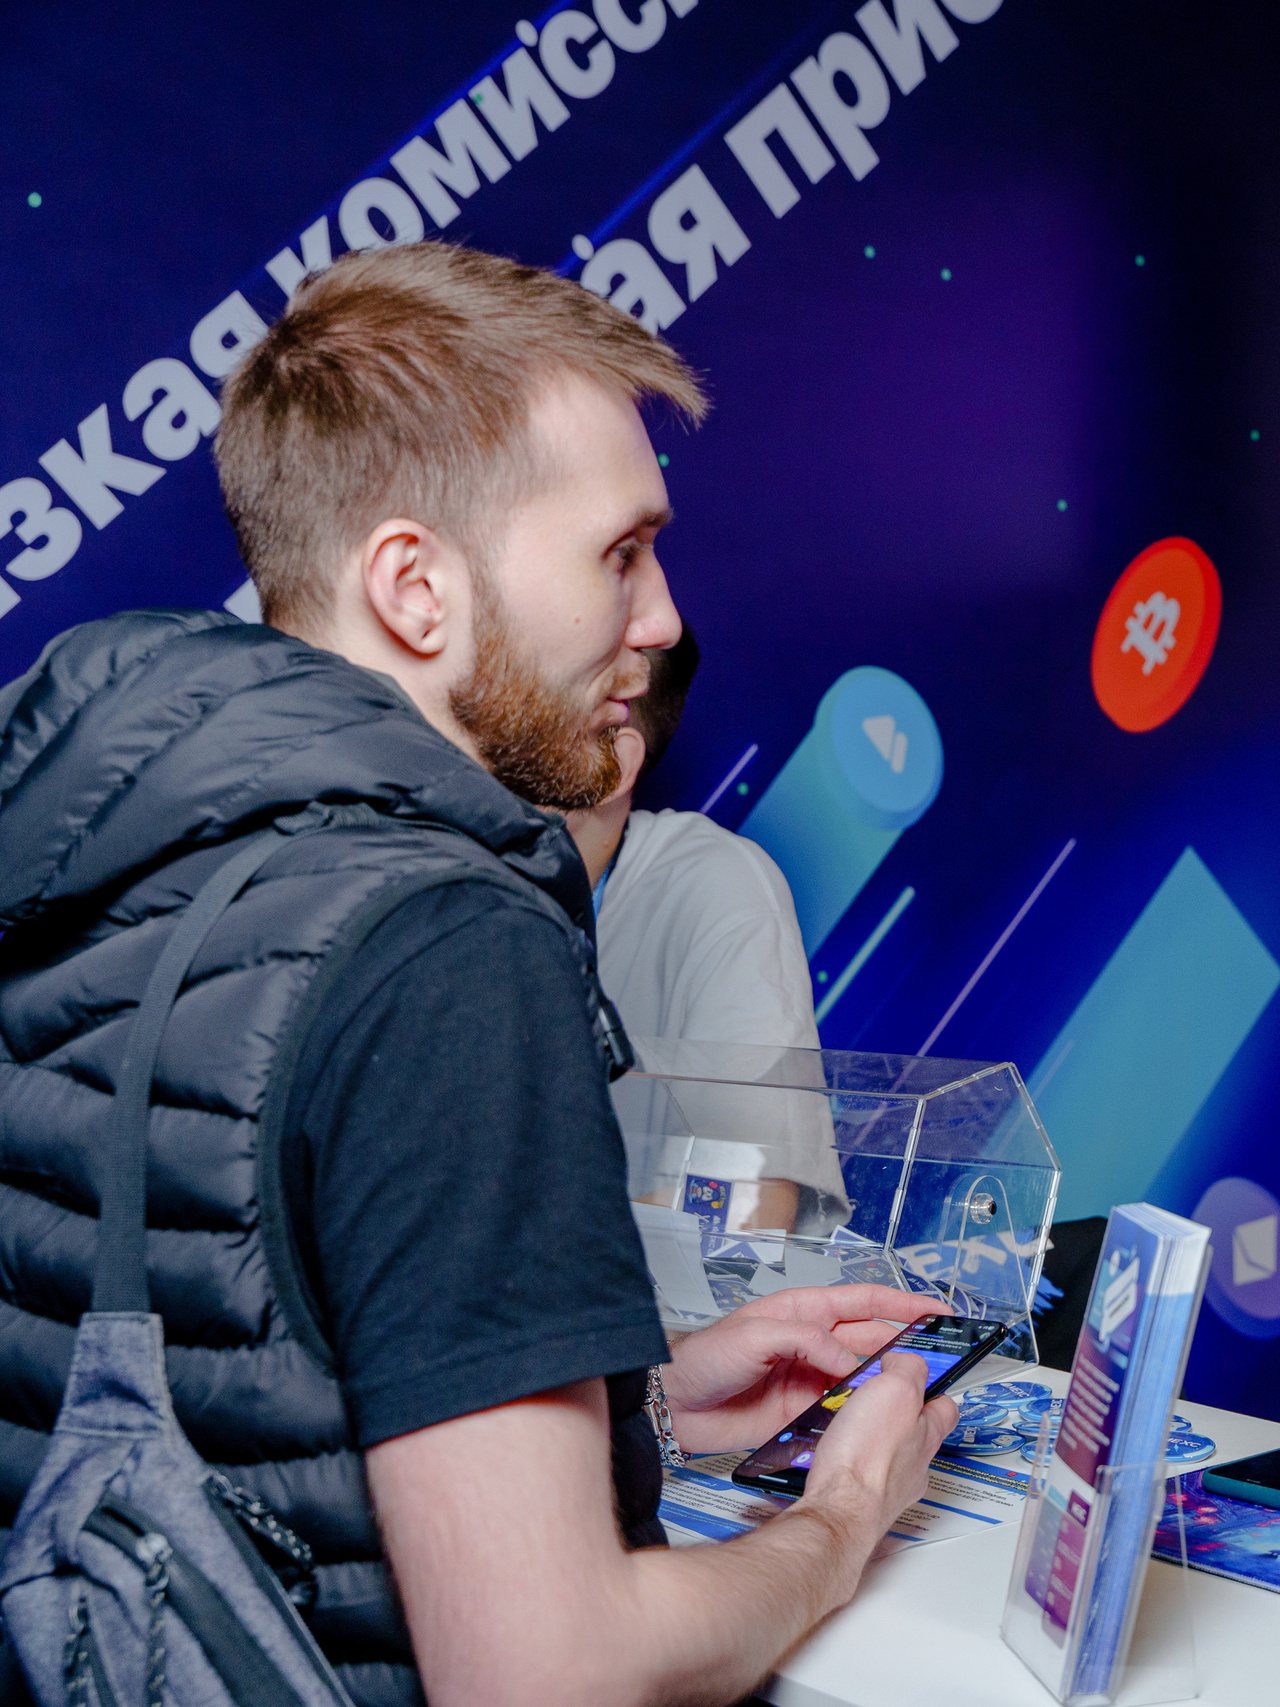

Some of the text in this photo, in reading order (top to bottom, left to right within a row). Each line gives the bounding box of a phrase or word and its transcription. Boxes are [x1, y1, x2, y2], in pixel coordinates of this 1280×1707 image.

[0, 0, 698, 620] зкая комисс
[724, 0, 1000, 219] при
